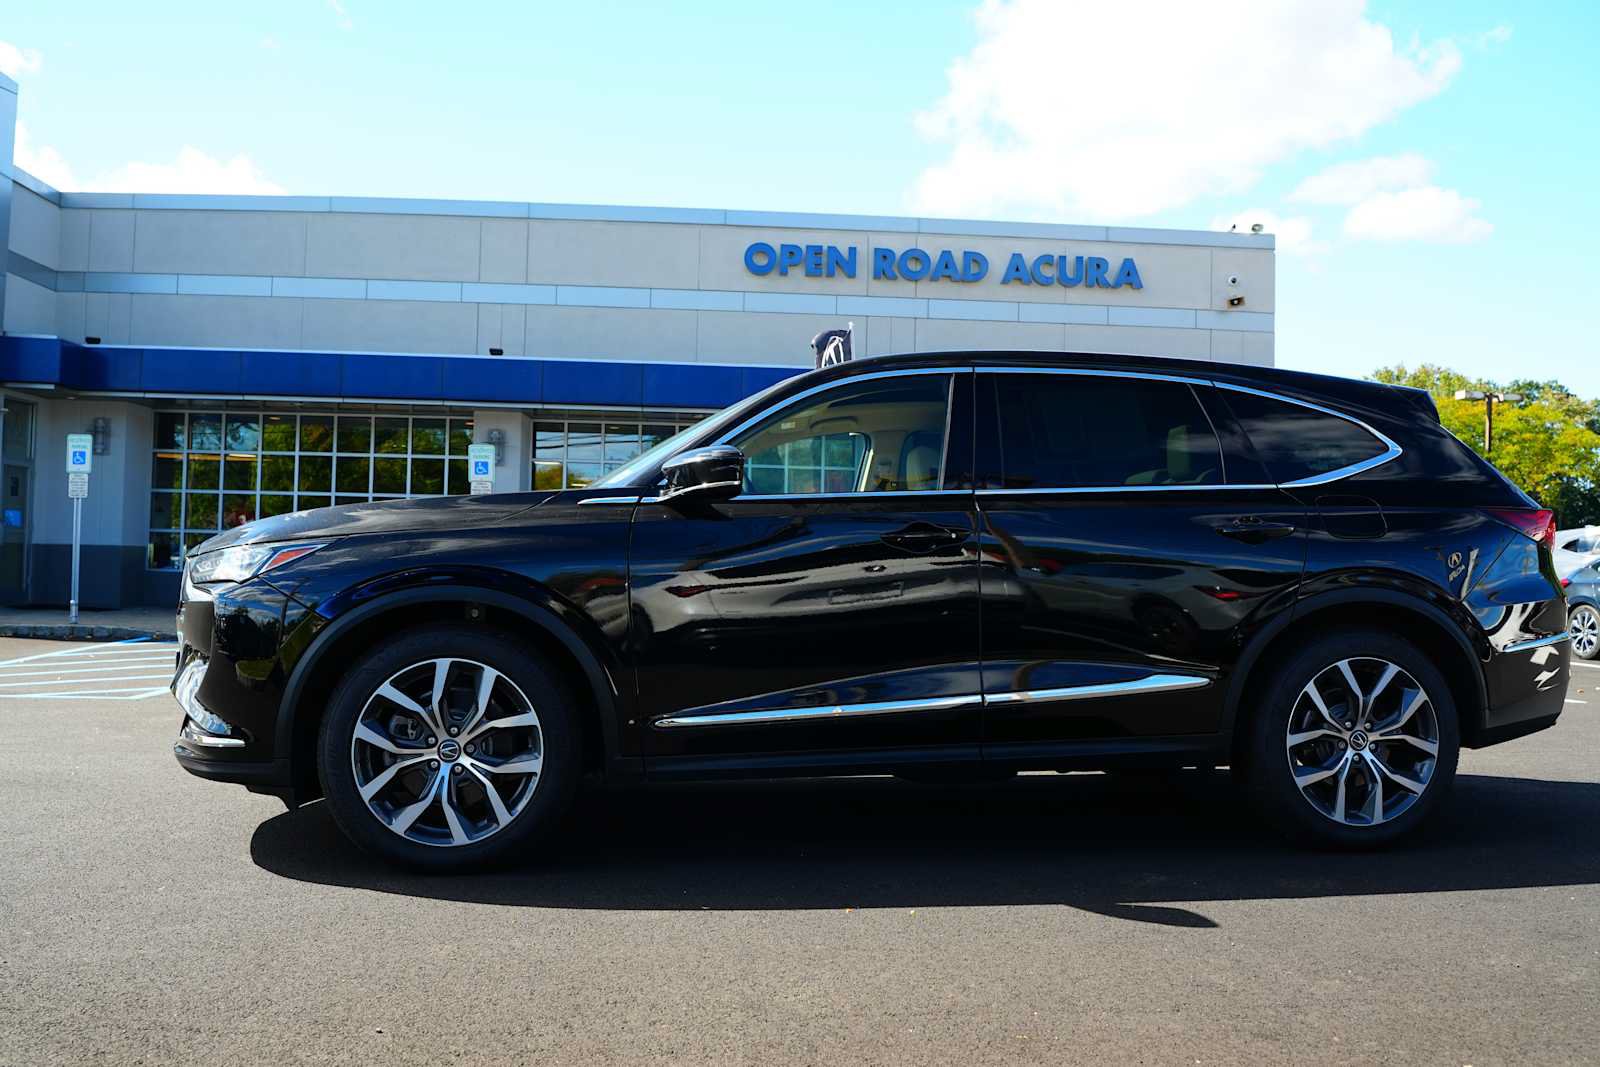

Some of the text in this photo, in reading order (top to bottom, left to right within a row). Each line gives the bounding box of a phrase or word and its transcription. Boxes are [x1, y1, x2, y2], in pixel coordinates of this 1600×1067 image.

[744, 242, 1144, 289] OPEN ROAD ACURA
